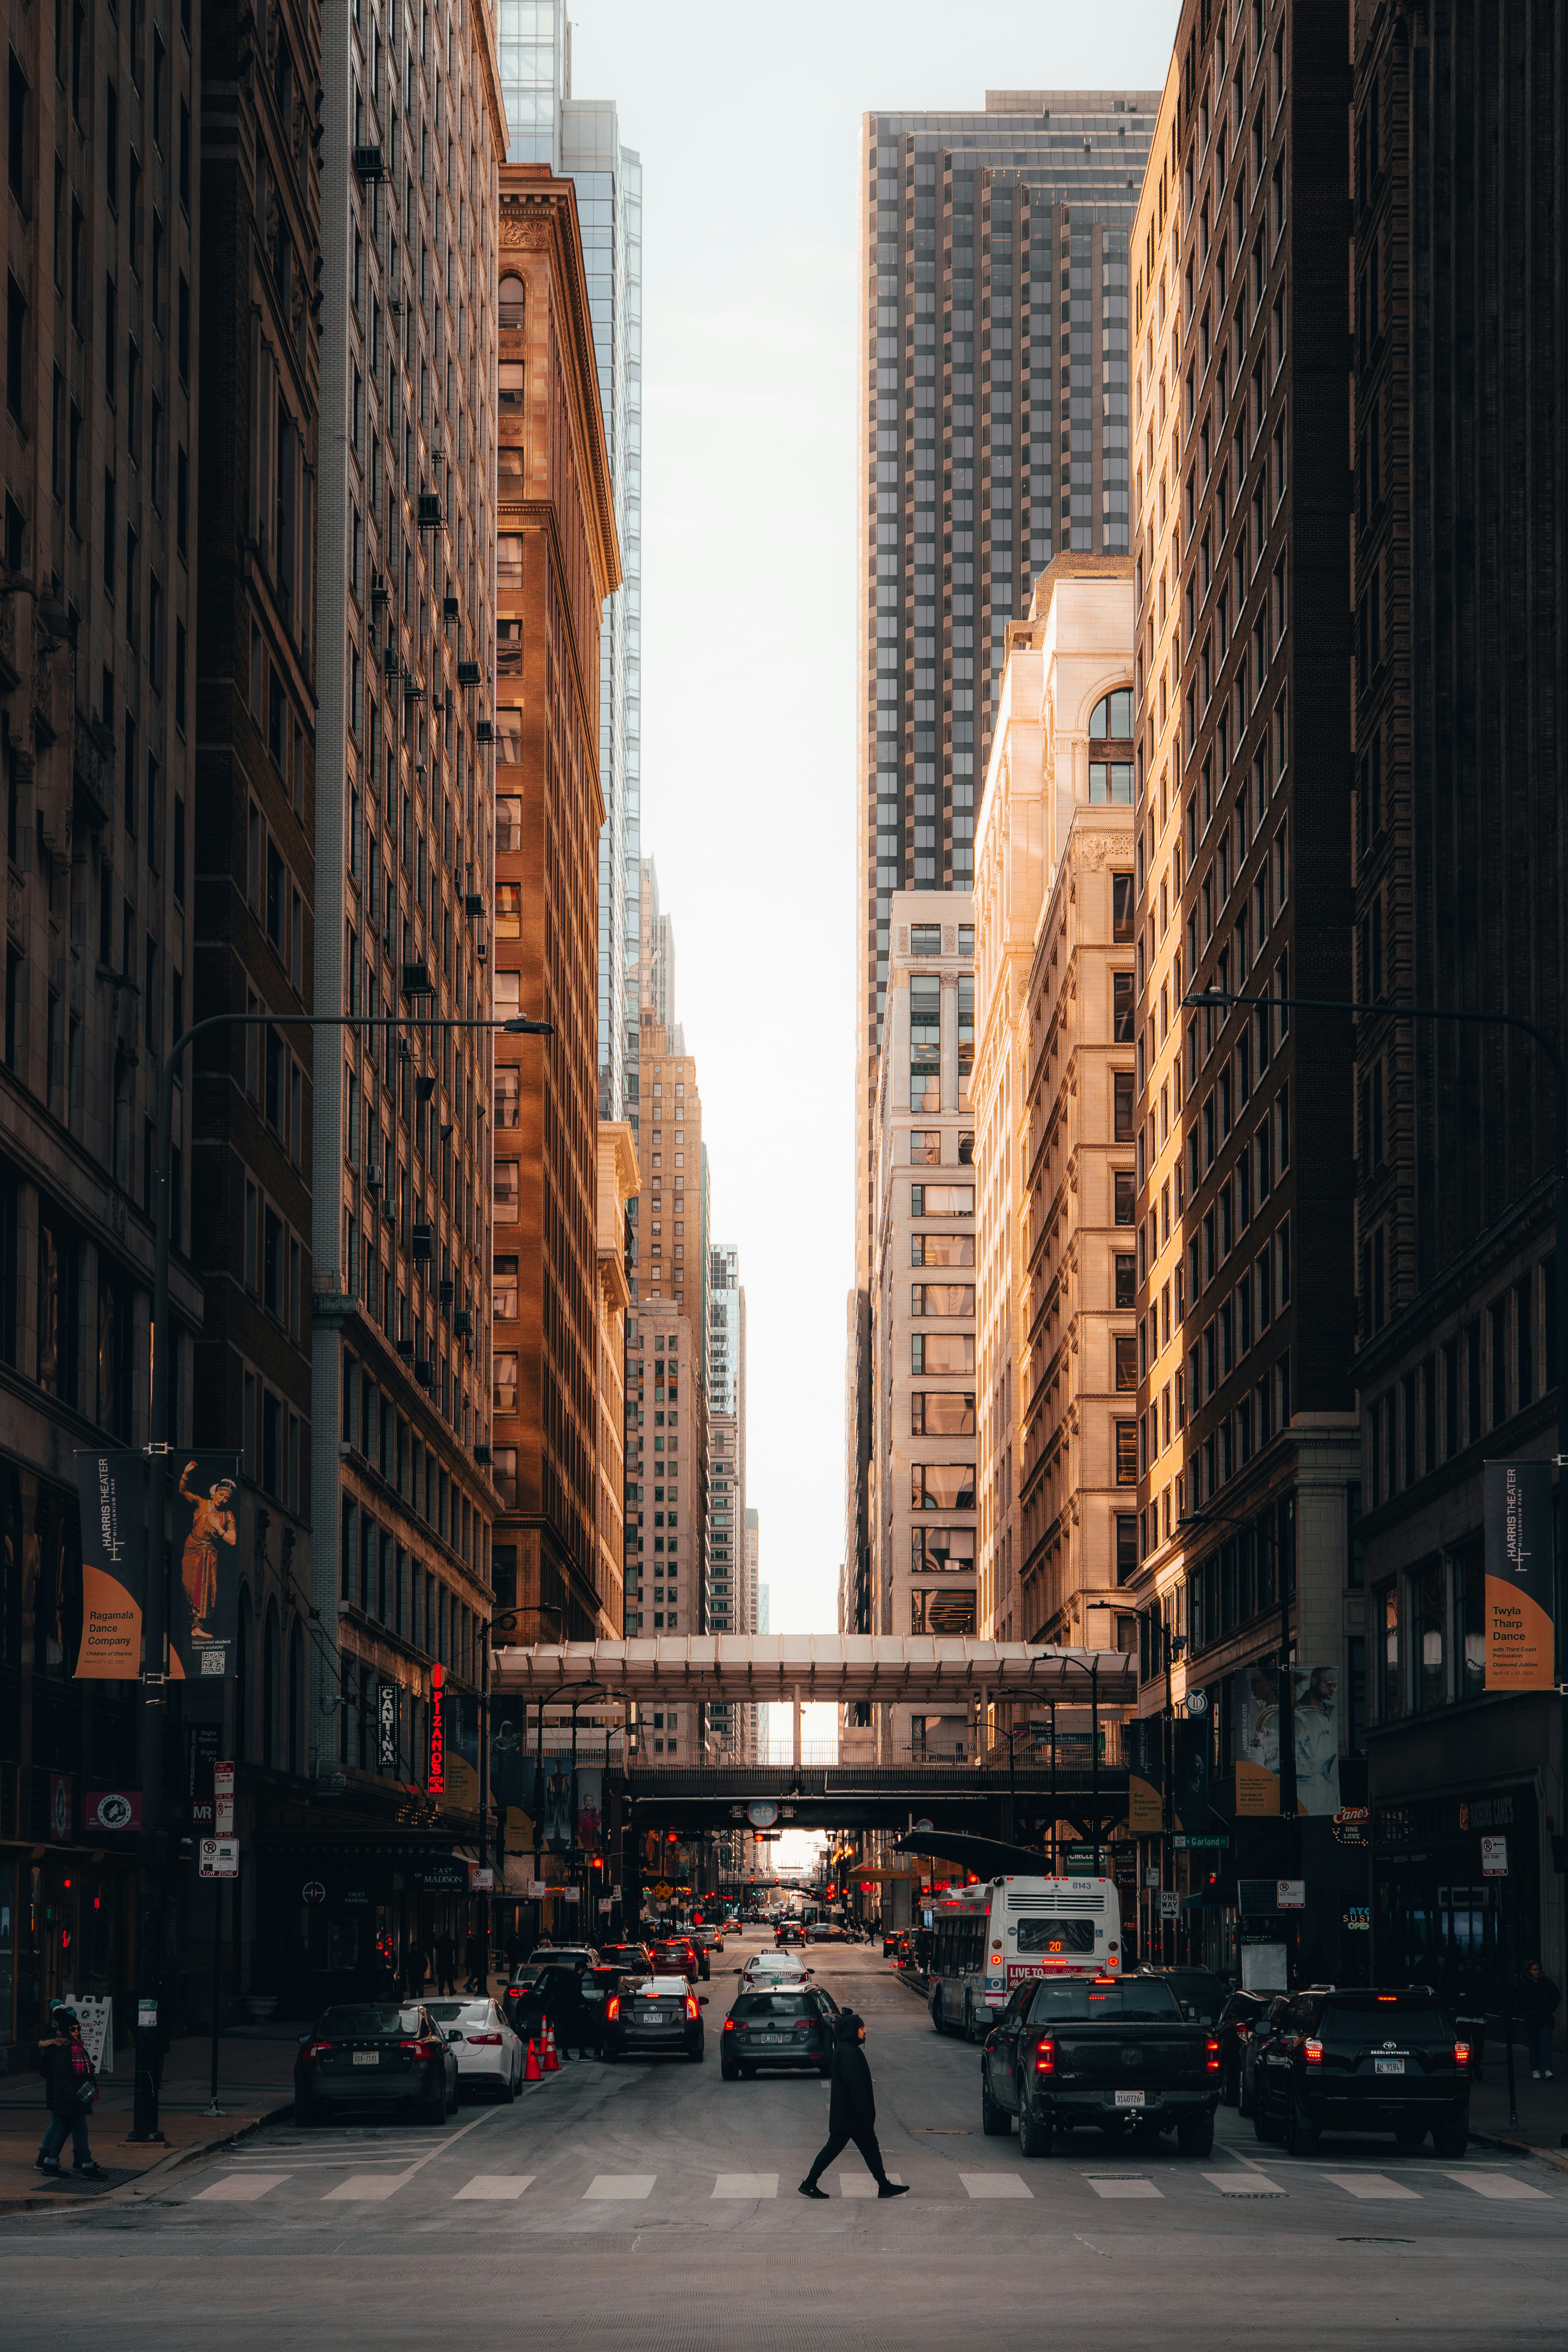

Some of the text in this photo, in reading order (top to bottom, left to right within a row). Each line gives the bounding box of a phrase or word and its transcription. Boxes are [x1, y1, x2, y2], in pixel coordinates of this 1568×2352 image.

[90, 1611, 133, 1621] Ragamala
[1493, 1607, 1521, 1617] Twyla
[89, 1624, 117, 1632] Dance
[1493, 1619, 1522, 1629] Tharp
[88, 1636, 130, 1646] Company
[1493, 1632, 1525, 1640] Dance
[382, 1689, 394, 1761] CANTINA
[101, 1796, 115, 1806] CHIYA
[118, 1797, 128, 1806] CHAI
[193, 1806, 212, 1819] MR
[753, 1807, 773, 1816] cta
[1191, 1837, 1219, 1846] Garland
[1049, 1941, 1061, 1951] 20
[1010, 1967, 1044, 1977] LIVE TO
